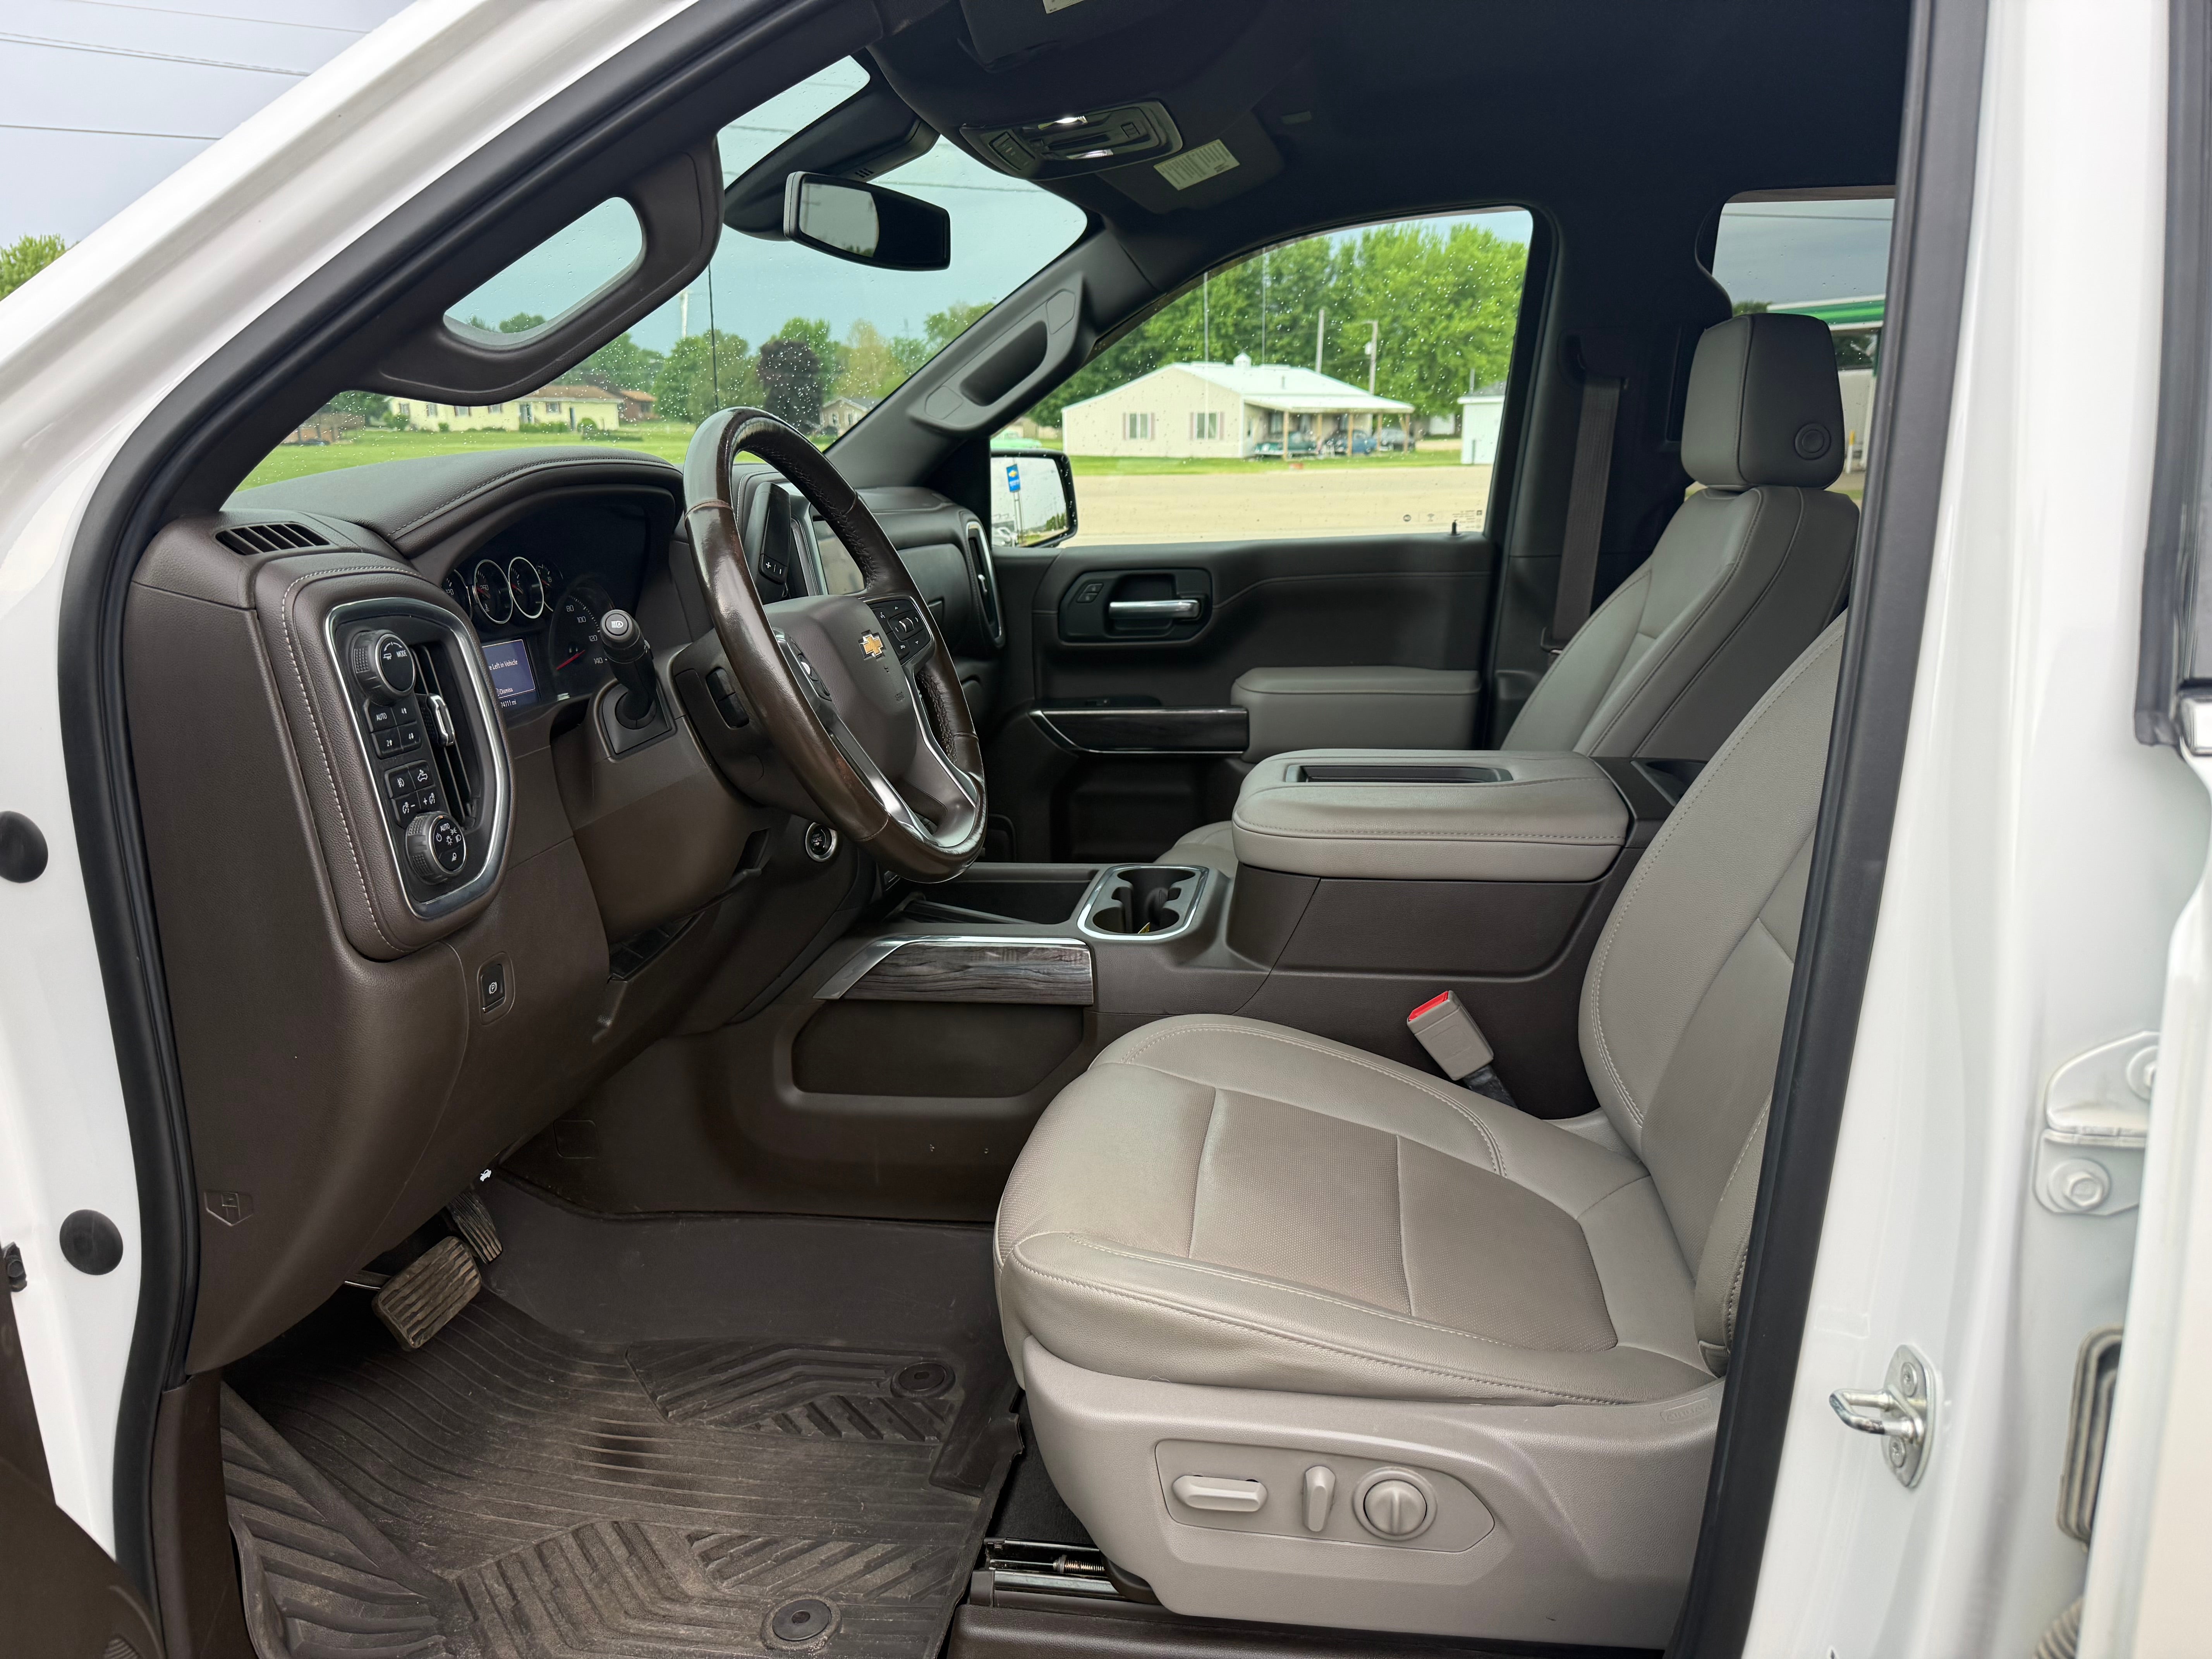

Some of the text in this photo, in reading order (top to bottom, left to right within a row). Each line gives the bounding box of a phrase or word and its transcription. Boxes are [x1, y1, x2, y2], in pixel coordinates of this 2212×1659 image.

[504, 659, 518, 667] Vehicle
[376, 713, 388, 721] AUTO
[440, 823, 450, 832] AUTO
